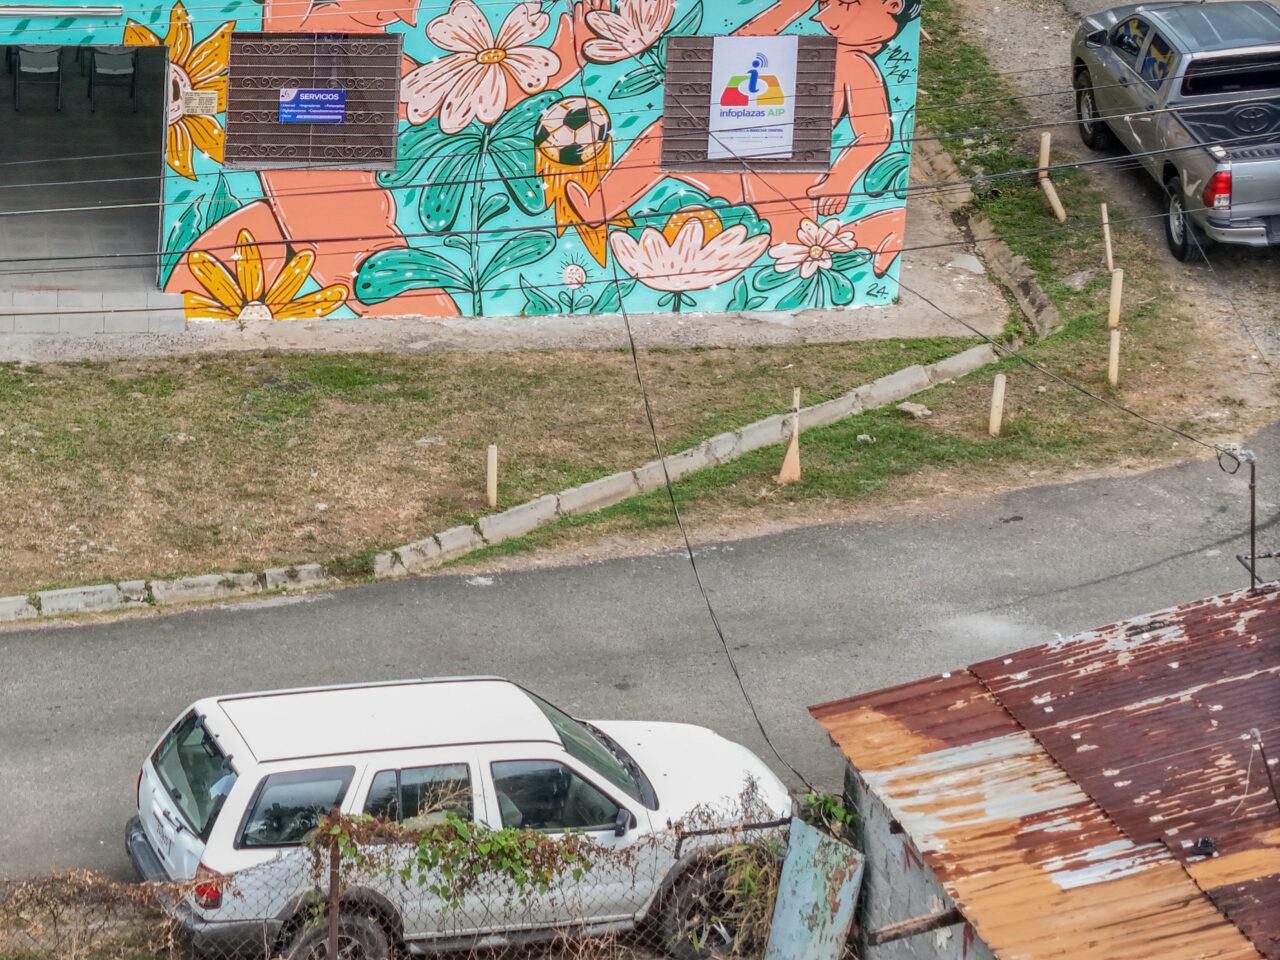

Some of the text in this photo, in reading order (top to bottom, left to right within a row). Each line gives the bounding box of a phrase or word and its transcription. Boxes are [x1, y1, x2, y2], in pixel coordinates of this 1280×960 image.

[299, 93, 340, 101] SERVICIOS
[720, 108, 786, 119] infoplazas AIP
